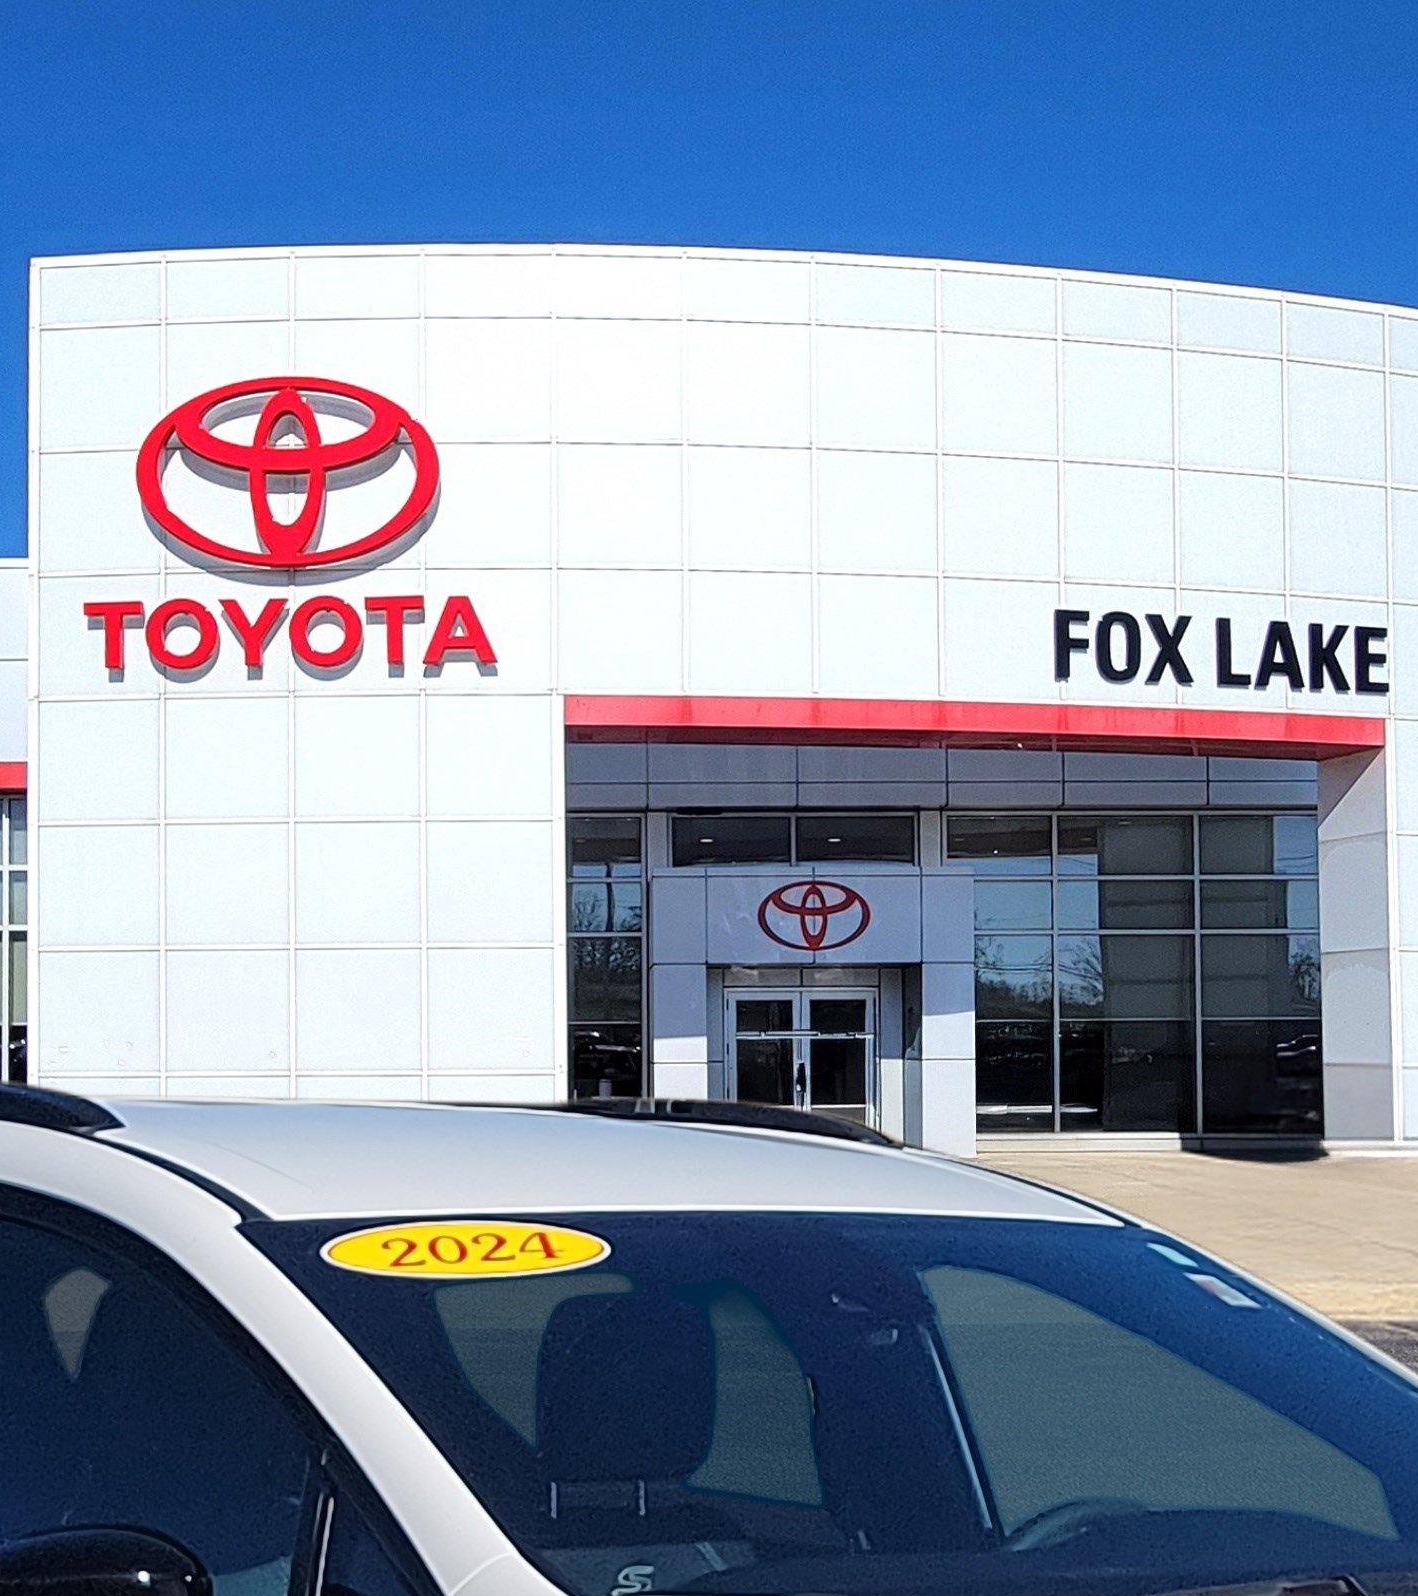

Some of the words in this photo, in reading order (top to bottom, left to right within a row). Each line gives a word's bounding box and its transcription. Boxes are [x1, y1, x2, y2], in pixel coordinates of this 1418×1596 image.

[83, 594, 499, 678] TOYOTA
[1053, 608, 1195, 686] FOX
[1215, 616, 1391, 695] LAKE
[381, 1231, 564, 1268] 2024
